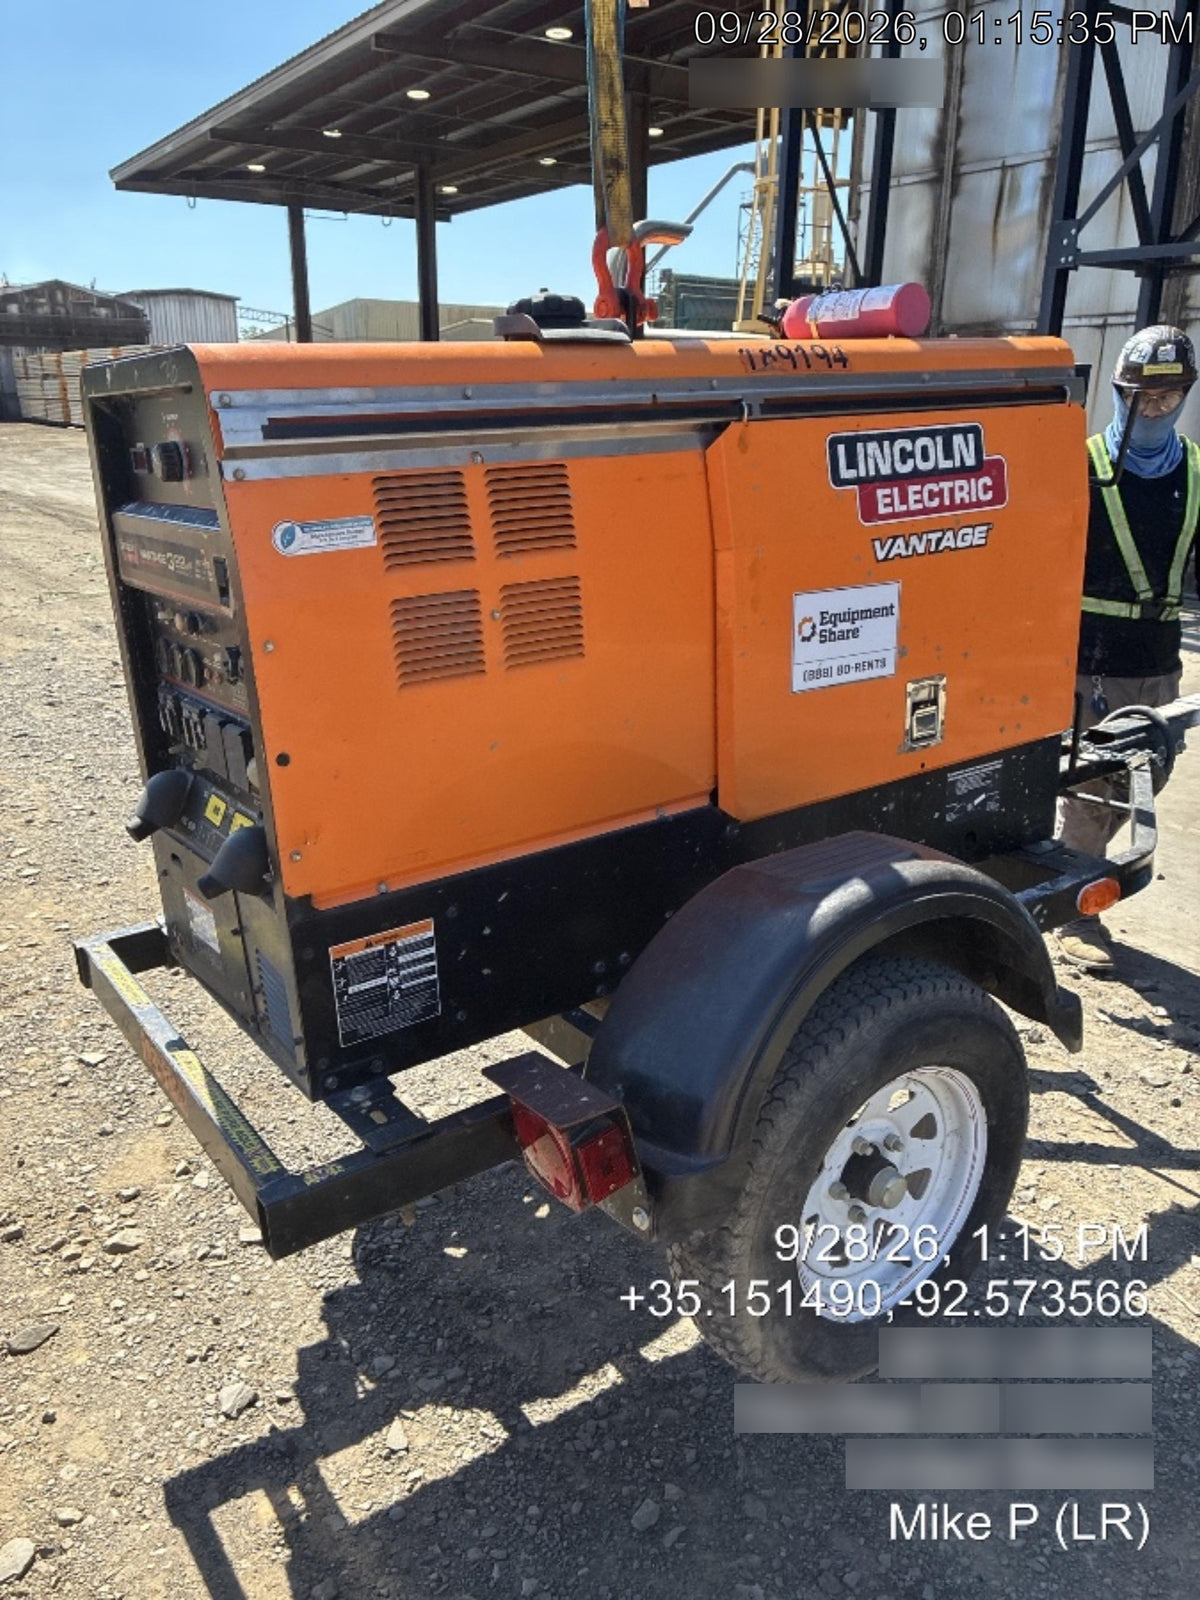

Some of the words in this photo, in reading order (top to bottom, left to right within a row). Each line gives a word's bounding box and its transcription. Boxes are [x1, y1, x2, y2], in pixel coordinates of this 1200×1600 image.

[836, 433, 977, 480] LINCOLN
[875, 475, 994, 515] ELECTRIC
[871, 524, 992, 562] VANTAGE
[819, 602, 895, 628] Equipment
[818, 627, 861, 645] Share
